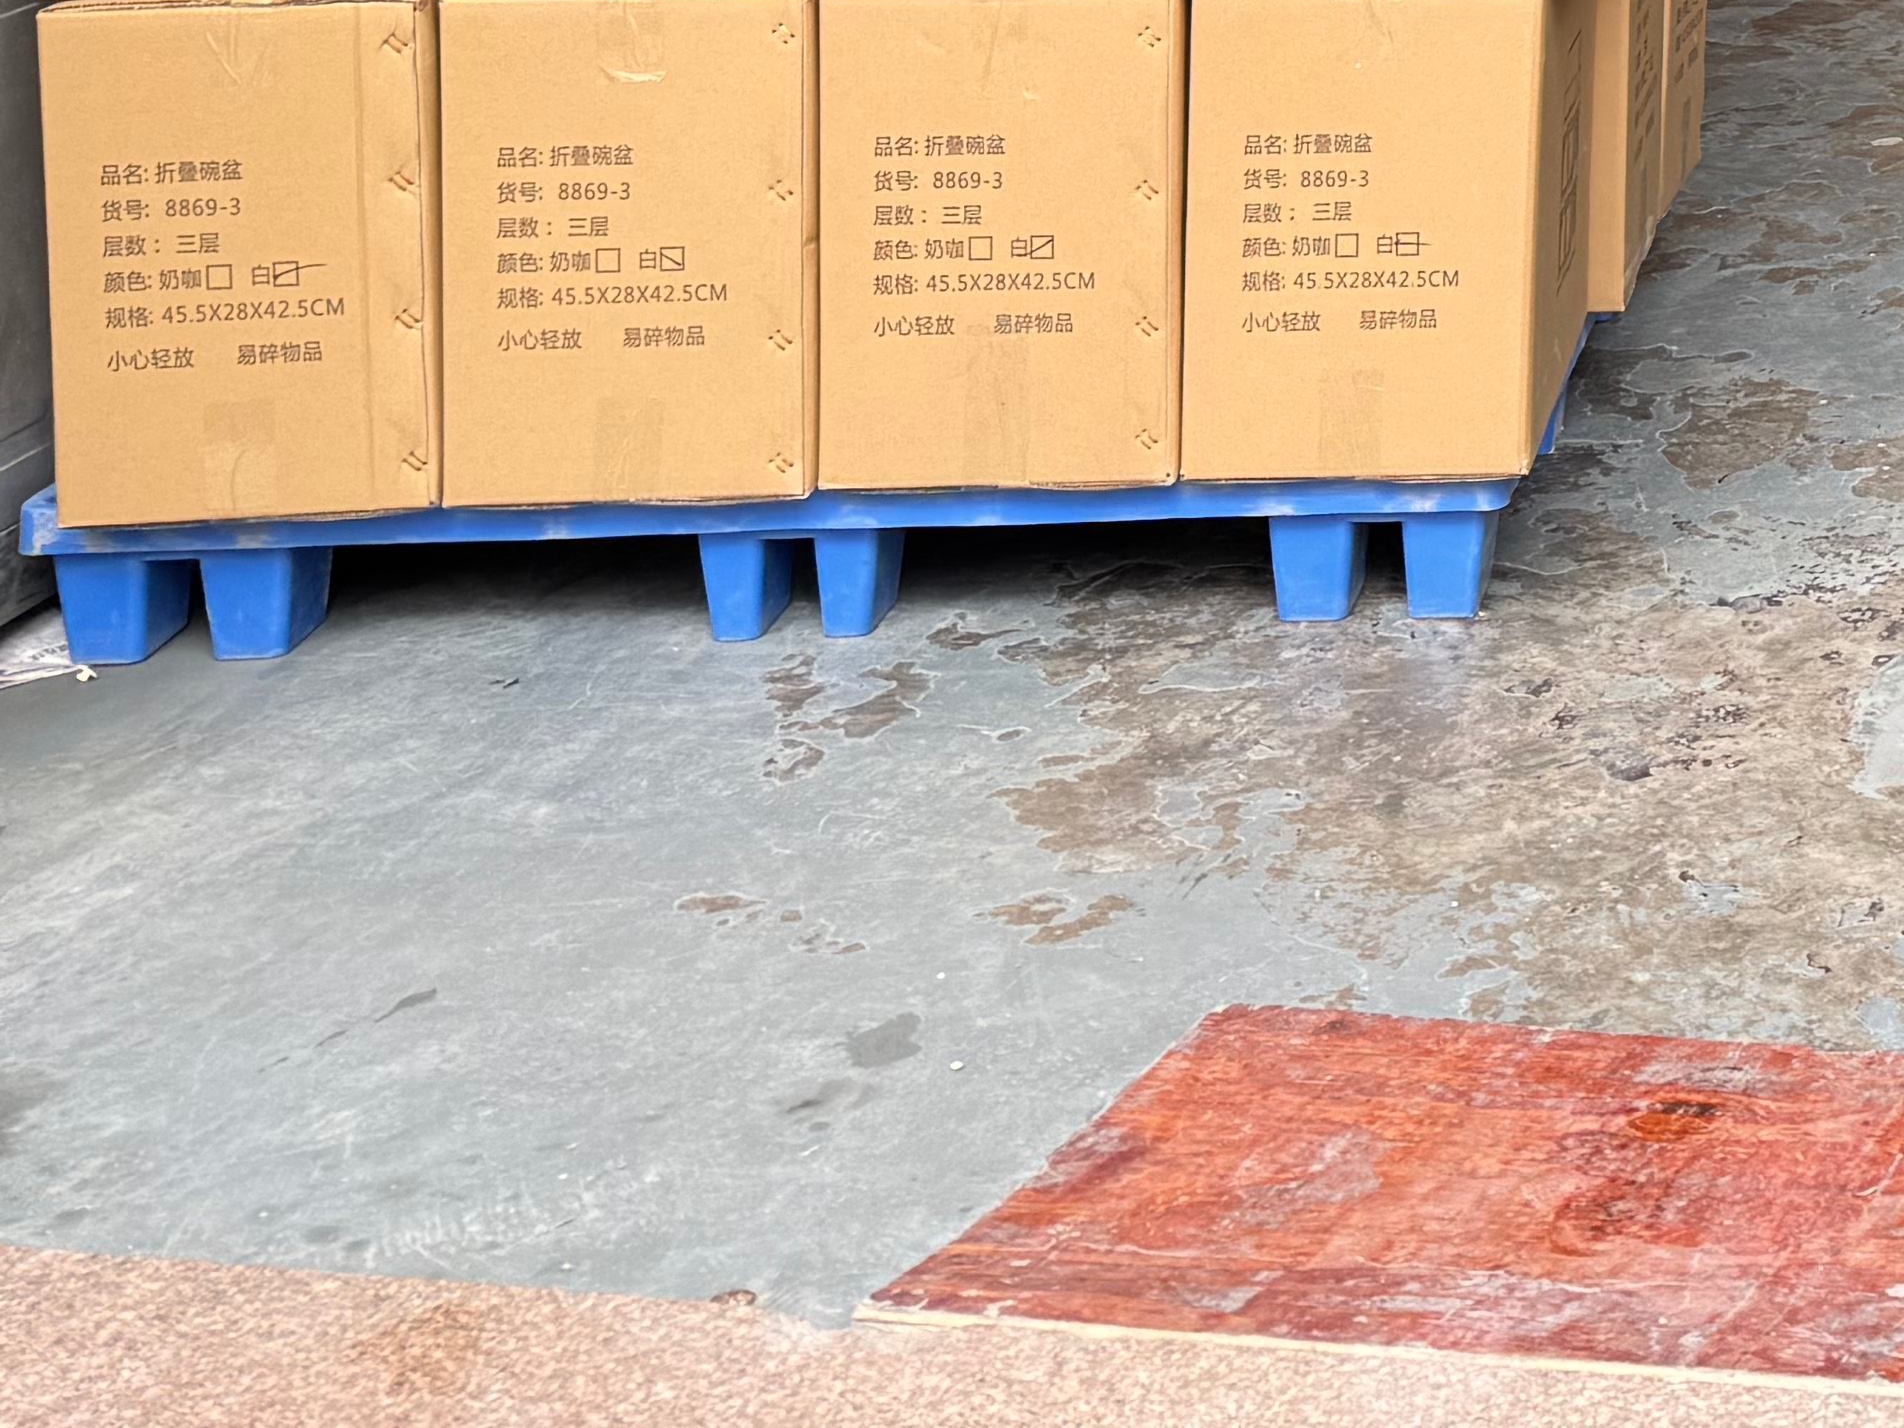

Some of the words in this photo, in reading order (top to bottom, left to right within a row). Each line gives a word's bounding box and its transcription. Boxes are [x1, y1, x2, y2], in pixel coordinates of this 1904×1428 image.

[933, 171, 1002, 189] 8869-3
[942, 205, 981, 225] 三层
[924, 239, 964, 259] 奶咖
[1010, 237, 1027, 257] 白
[927, 272, 1094, 291] 45.5X28X42.5CM
[874, 314, 954, 336] 小心轻放
[994, 312, 1073, 334] 易碎物品
